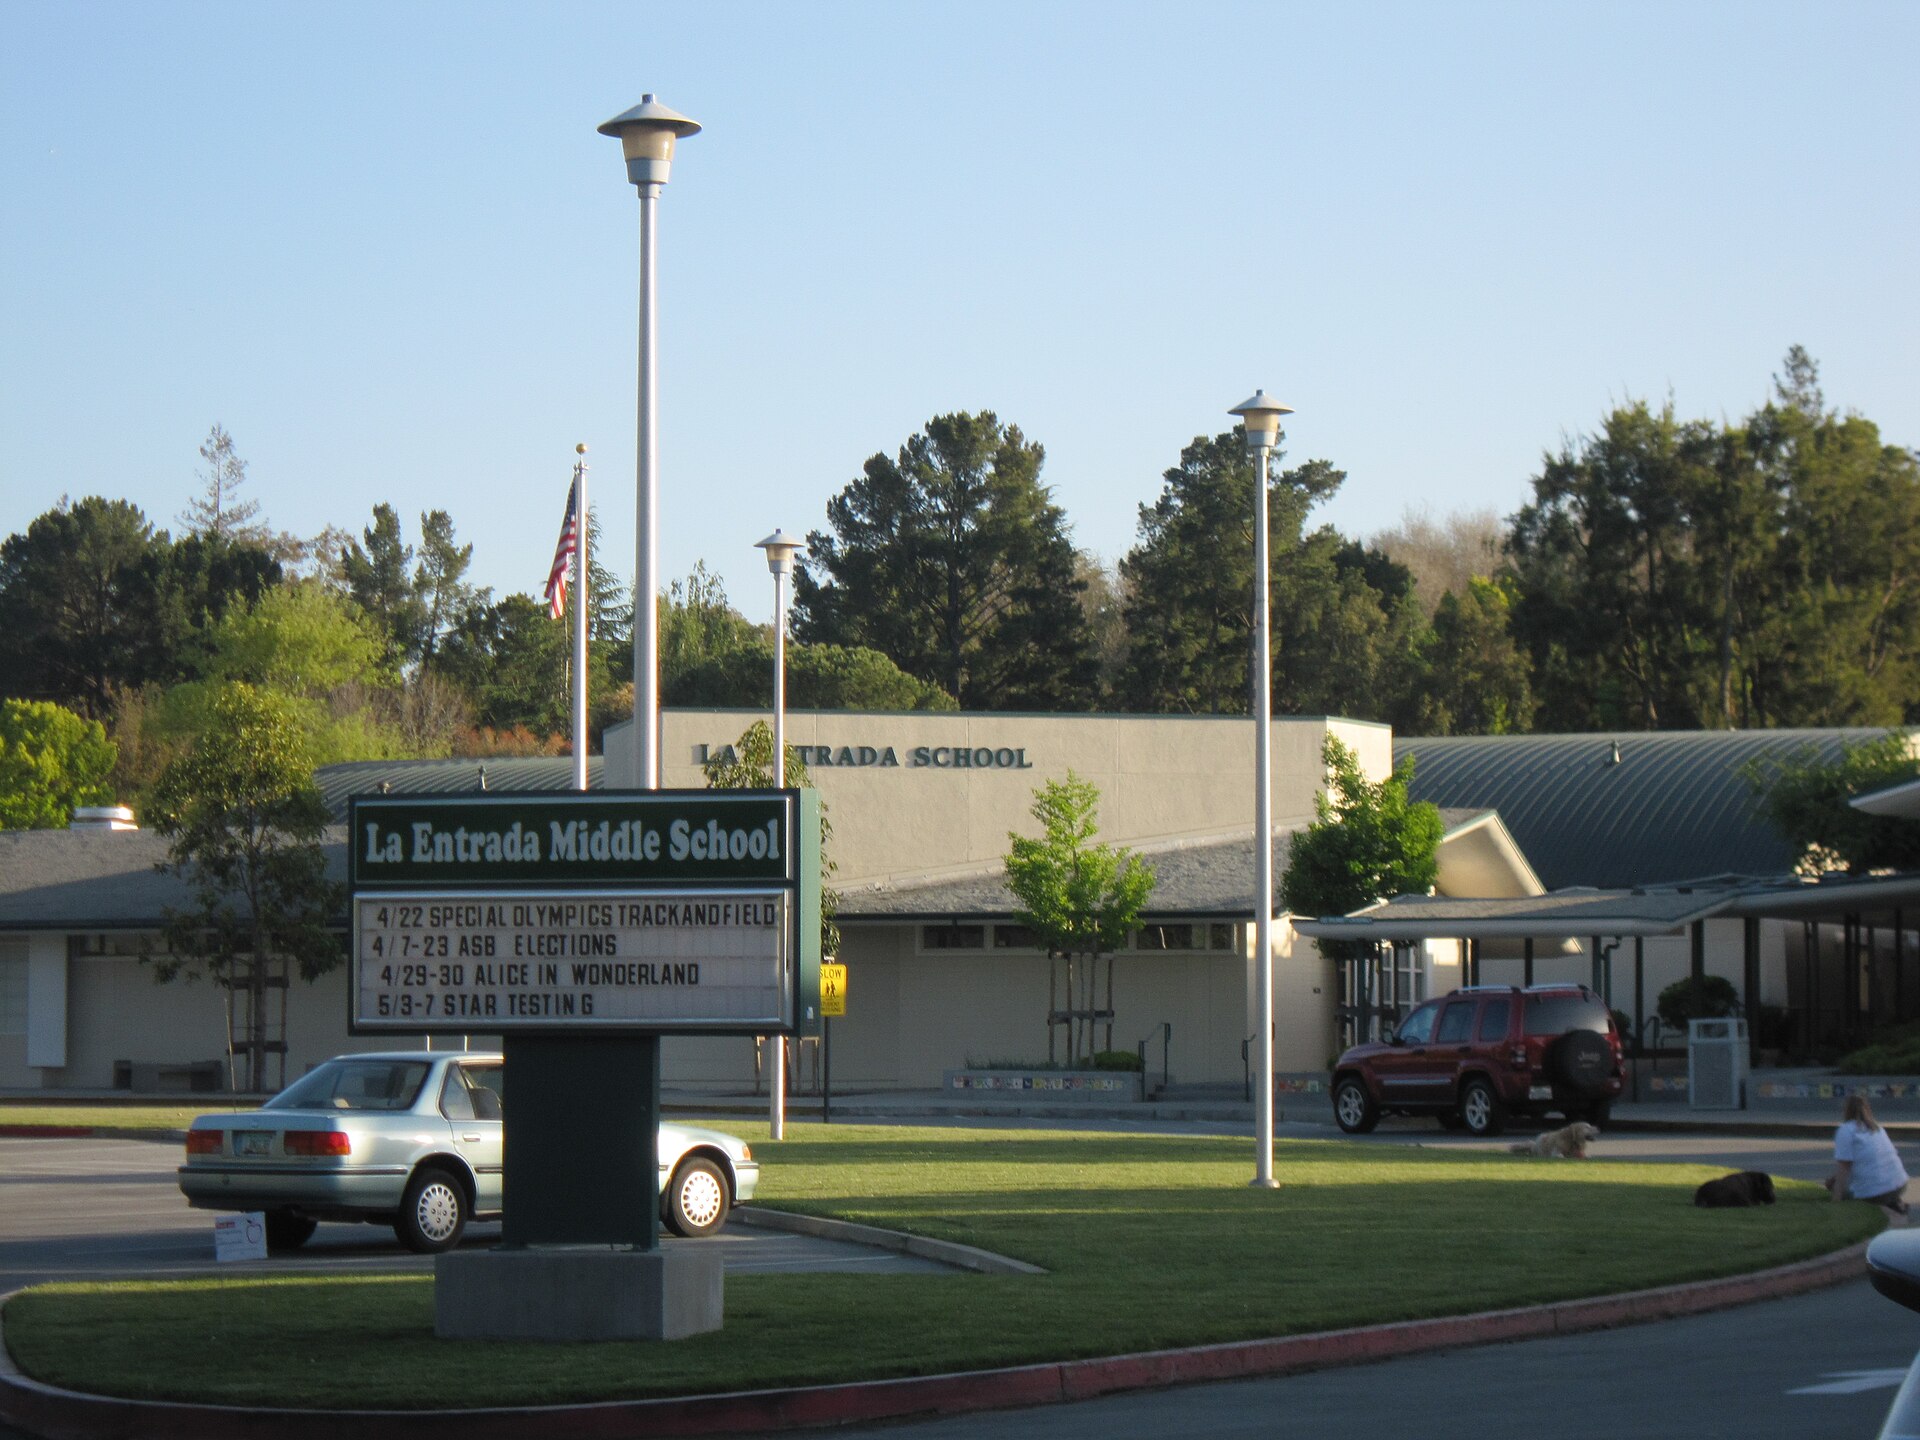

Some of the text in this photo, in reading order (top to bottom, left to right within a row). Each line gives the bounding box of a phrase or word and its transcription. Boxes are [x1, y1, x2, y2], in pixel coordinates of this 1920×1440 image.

[699, 743, 1033, 768] LA TRADA SCHOOL
[366, 818, 780, 863] La Entrada Middle School
[377, 906, 423, 928] 4/22
[429, 905, 507, 928] SPECIAL
[513, 904, 613, 927] OLYMPICS
[372, 934, 617, 957] 4/7-23 ASB ELECTIONS
[380, 963, 699, 987] 4/29-30 ALICE IN WONDERLAND
[378, 993, 593, 1016] 5/3-7 STAR TESTING
